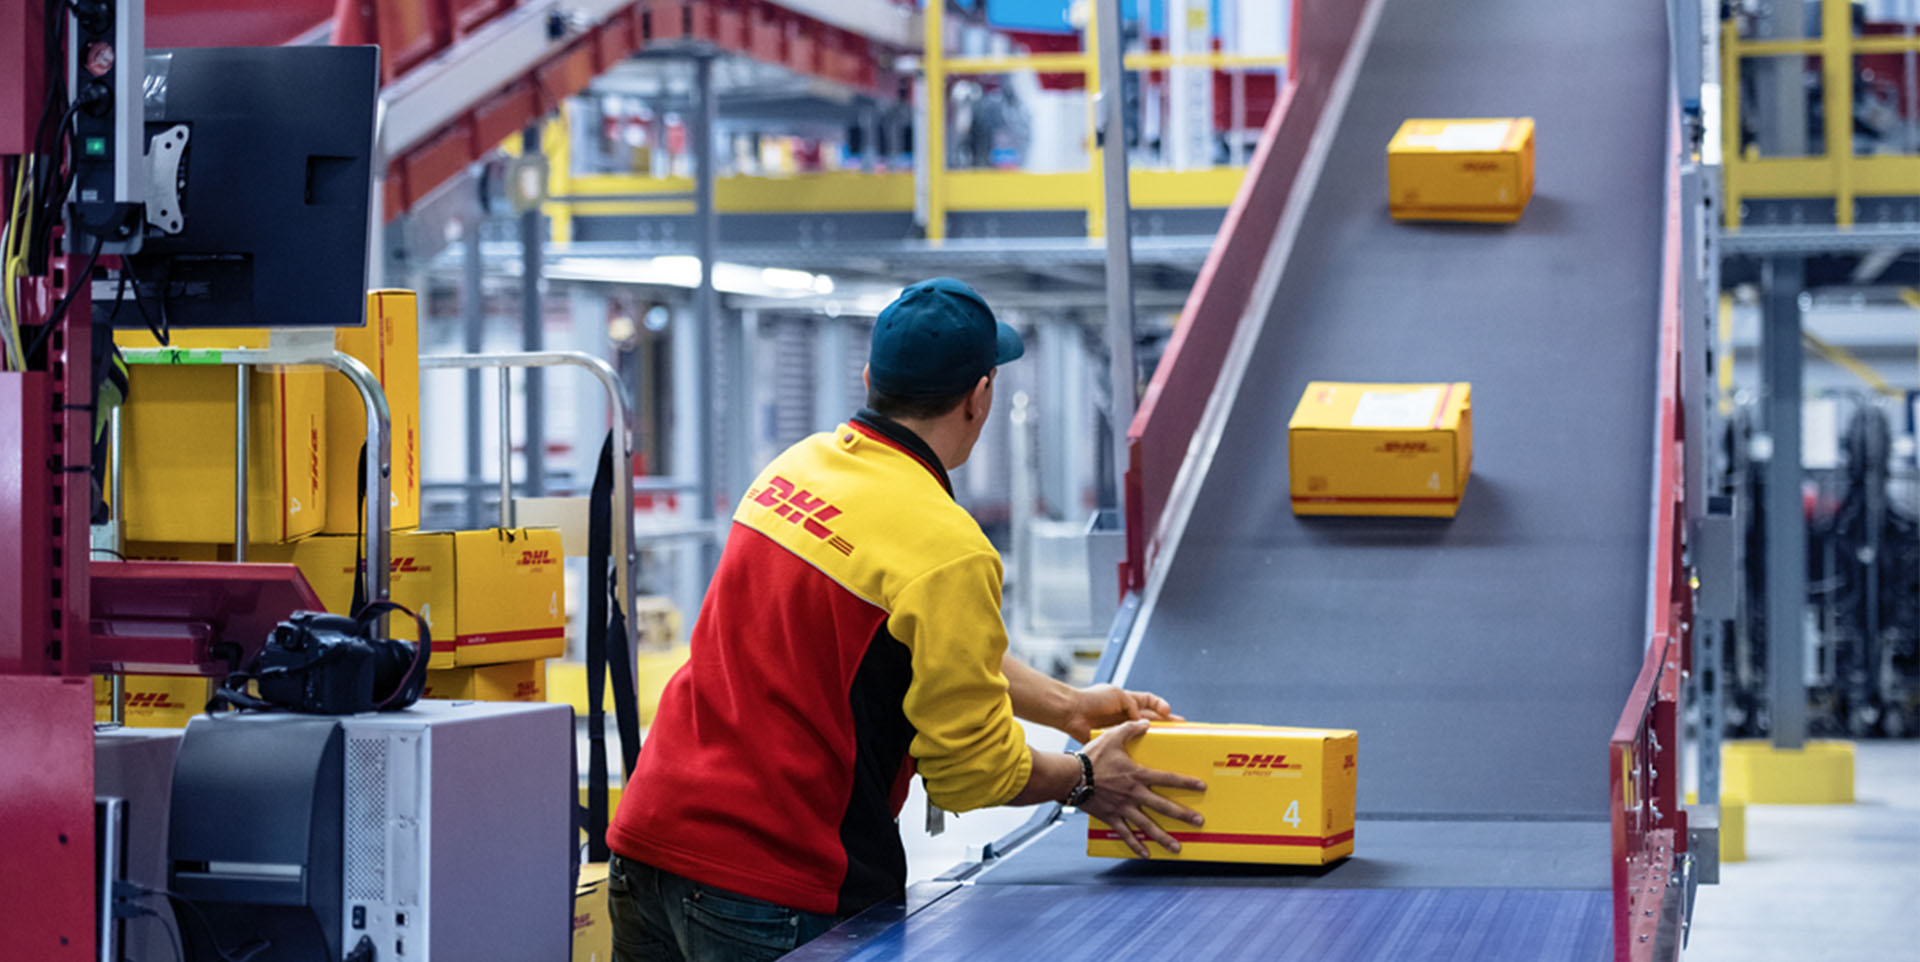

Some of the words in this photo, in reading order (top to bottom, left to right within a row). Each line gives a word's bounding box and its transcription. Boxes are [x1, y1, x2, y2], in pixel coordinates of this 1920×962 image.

[754, 476, 843, 540] DHL
[521, 550, 551, 566] DHL
[1226, 754, 1289, 769] DHL
[1283, 800, 1301, 829] 4
